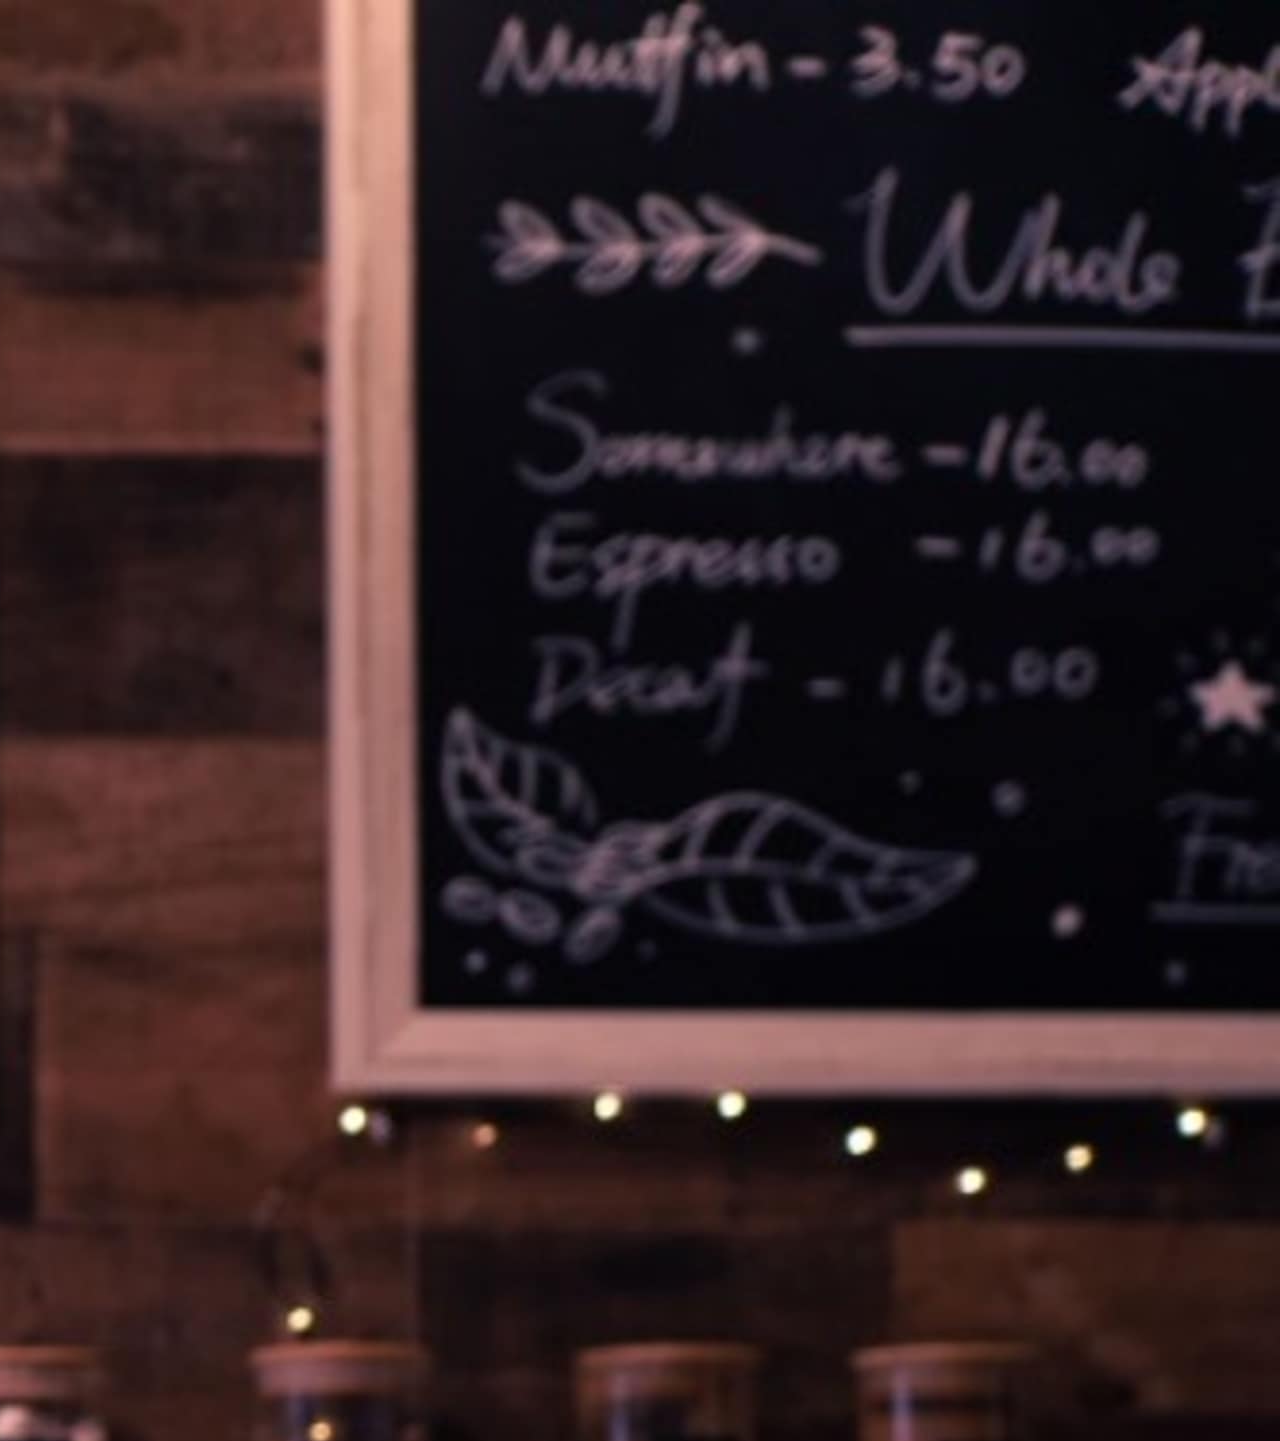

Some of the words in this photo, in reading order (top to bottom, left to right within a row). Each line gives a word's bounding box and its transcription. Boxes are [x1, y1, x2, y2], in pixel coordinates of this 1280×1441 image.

[850, 25, 1026, 101] 3.50
[845, 166, 1181, 314] Whole
[516, 370, 902, 493] Somewhere
[528, 512, 841, 653] Espresso
[528, 621, 768, 753] Decaf
